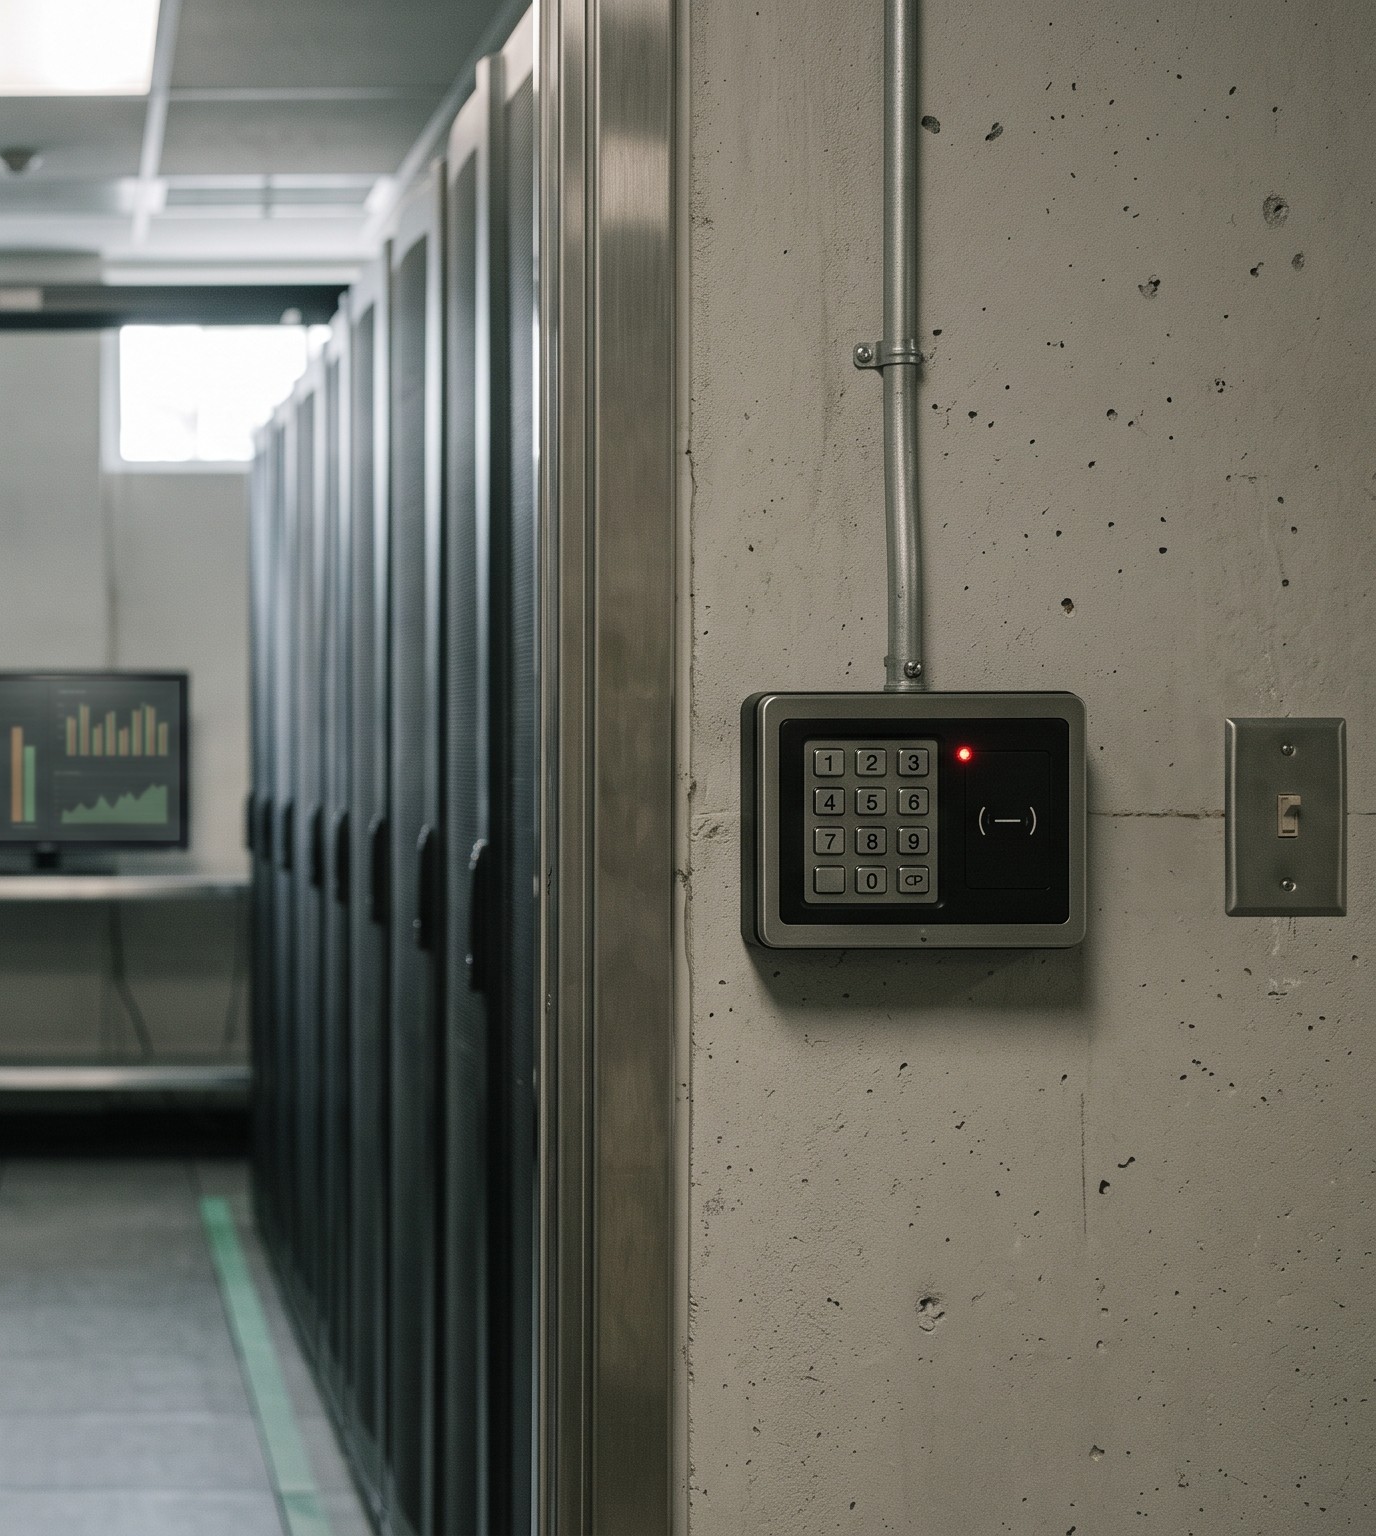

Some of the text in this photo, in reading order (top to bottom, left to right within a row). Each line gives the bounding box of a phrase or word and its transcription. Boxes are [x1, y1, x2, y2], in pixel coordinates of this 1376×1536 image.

[824, 754, 920, 772] 1 2 3
[824, 794, 920, 811] 4 5 6
[824, 833, 920, 850] 7 8 9
[866, 873, 878, 890] 0
